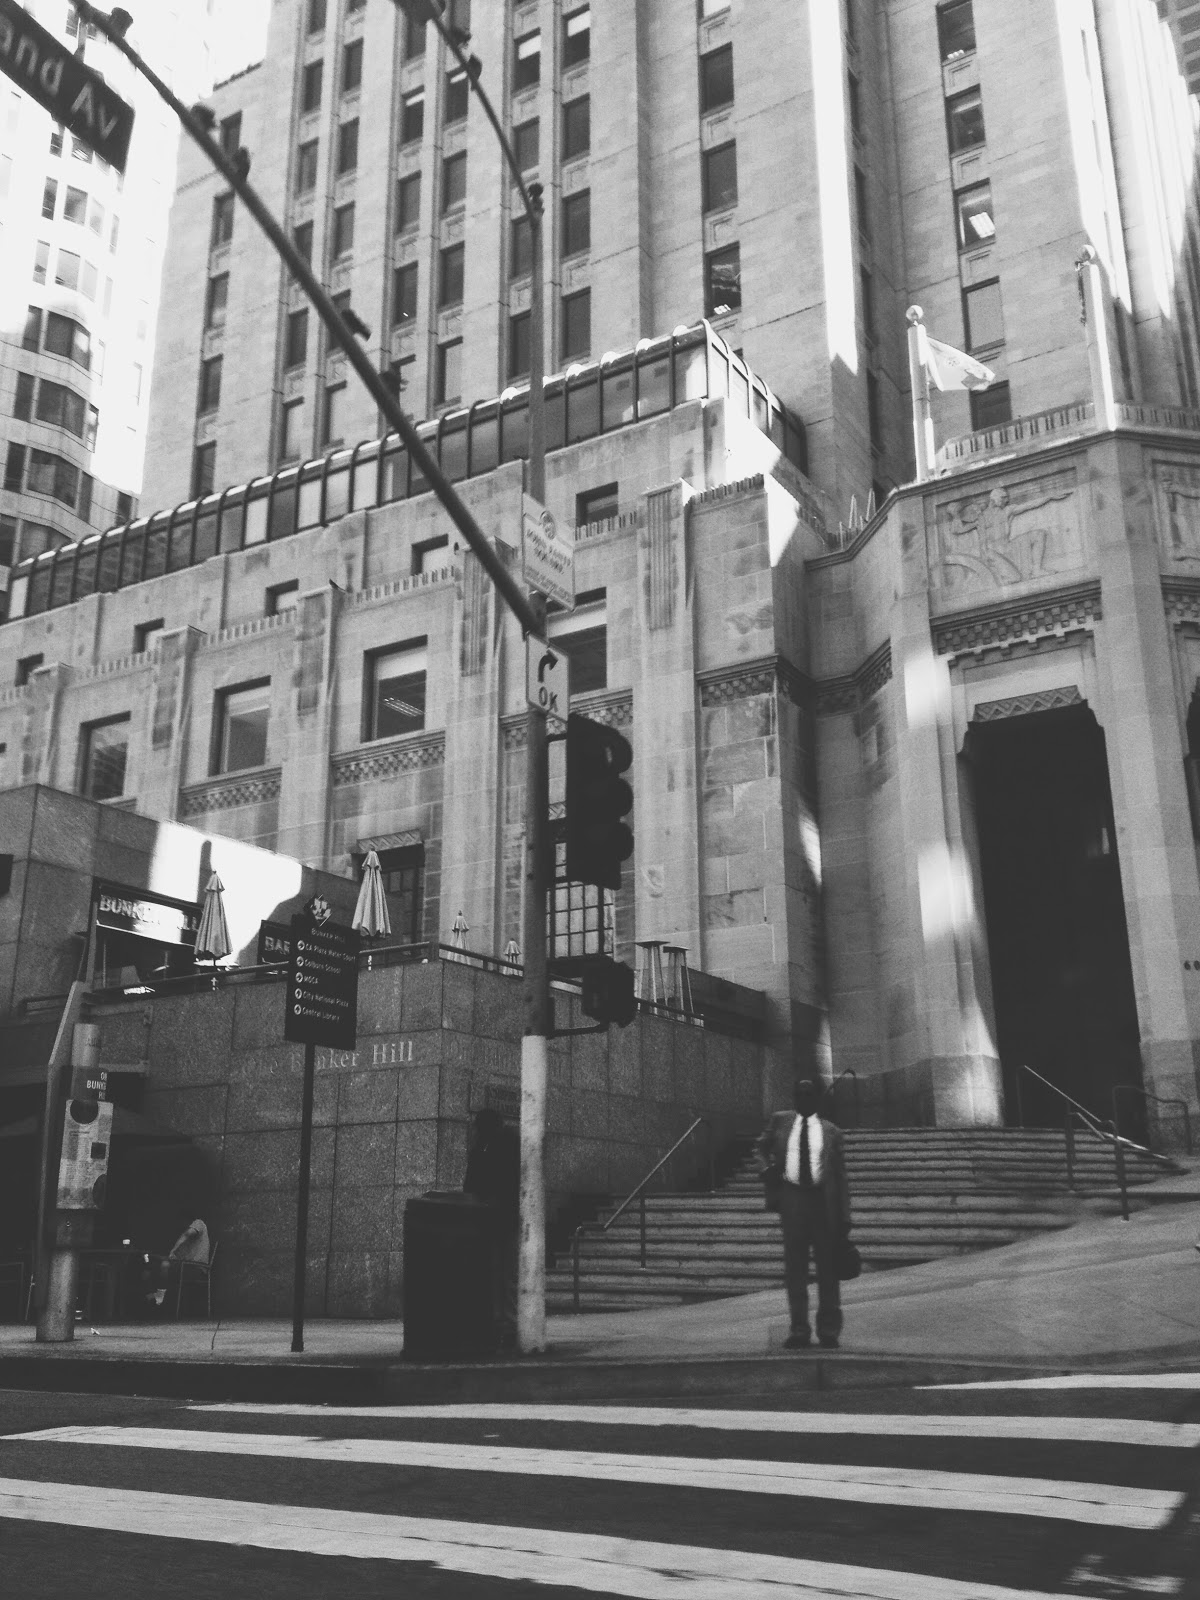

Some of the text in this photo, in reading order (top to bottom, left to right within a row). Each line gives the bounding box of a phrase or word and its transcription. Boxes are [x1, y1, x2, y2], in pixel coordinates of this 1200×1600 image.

[70, 79, 118, 142] Av
[538, 685, 559, 713] OK
[372, 1040, 413, 1064] Hill
